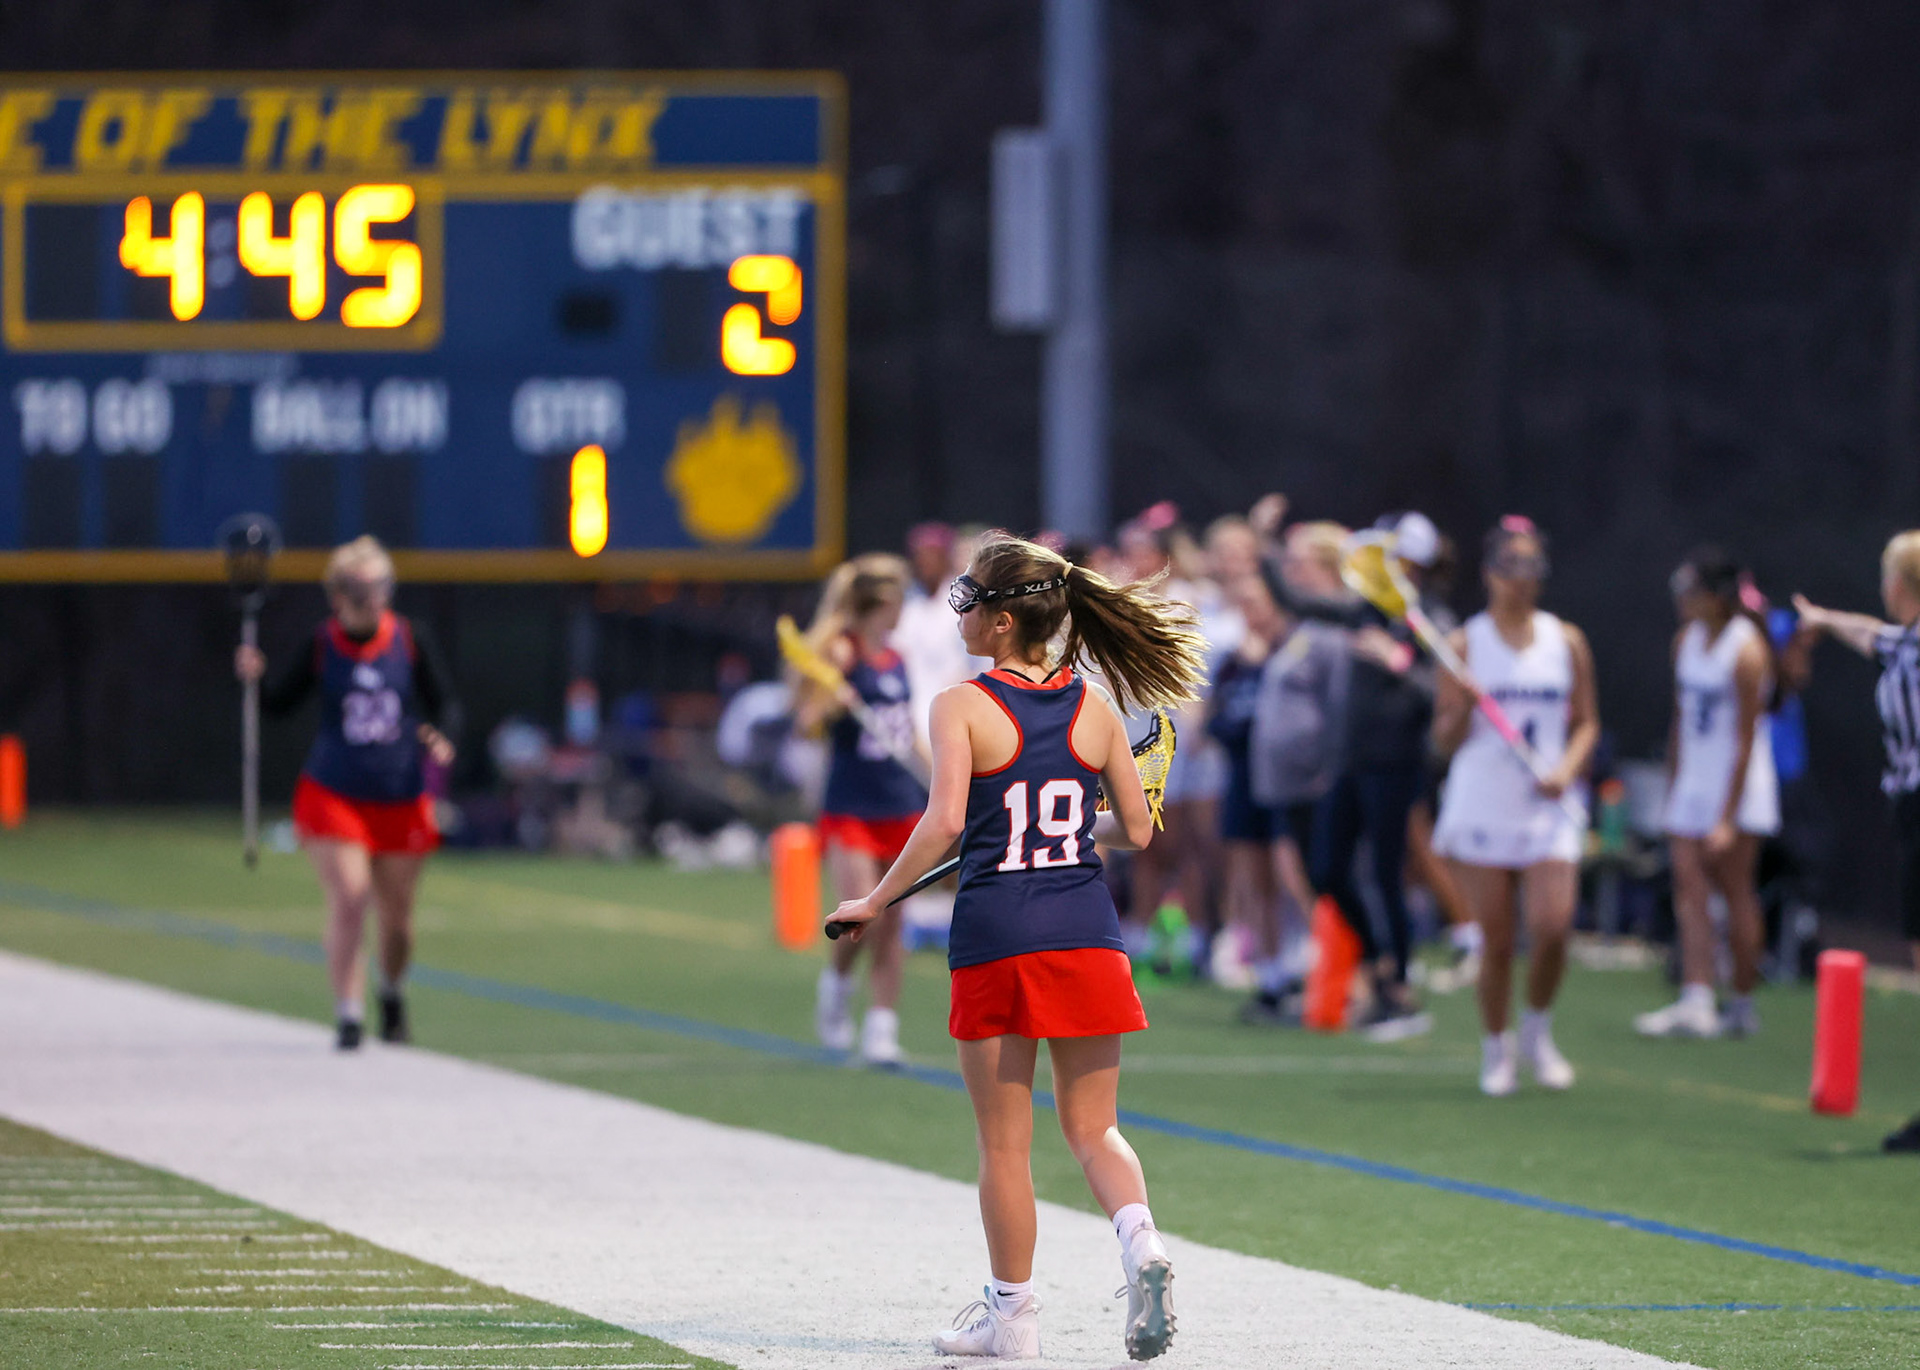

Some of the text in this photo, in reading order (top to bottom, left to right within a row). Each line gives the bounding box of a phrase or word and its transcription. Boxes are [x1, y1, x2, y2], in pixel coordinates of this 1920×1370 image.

[75, 89, 207, 170] OF
[238, 88, 418, 170] THE
[436, 87, 666, 170] LYNX
[572, 186, 806, 268] GUEST
[721, 254, 802, 375] 2
[18, 379, 172, 454] TO GO
[252, 379, 448, 453] BALL ON
[569, 444, 608, 558] 1
[997, 778, 1085, 872] 19
